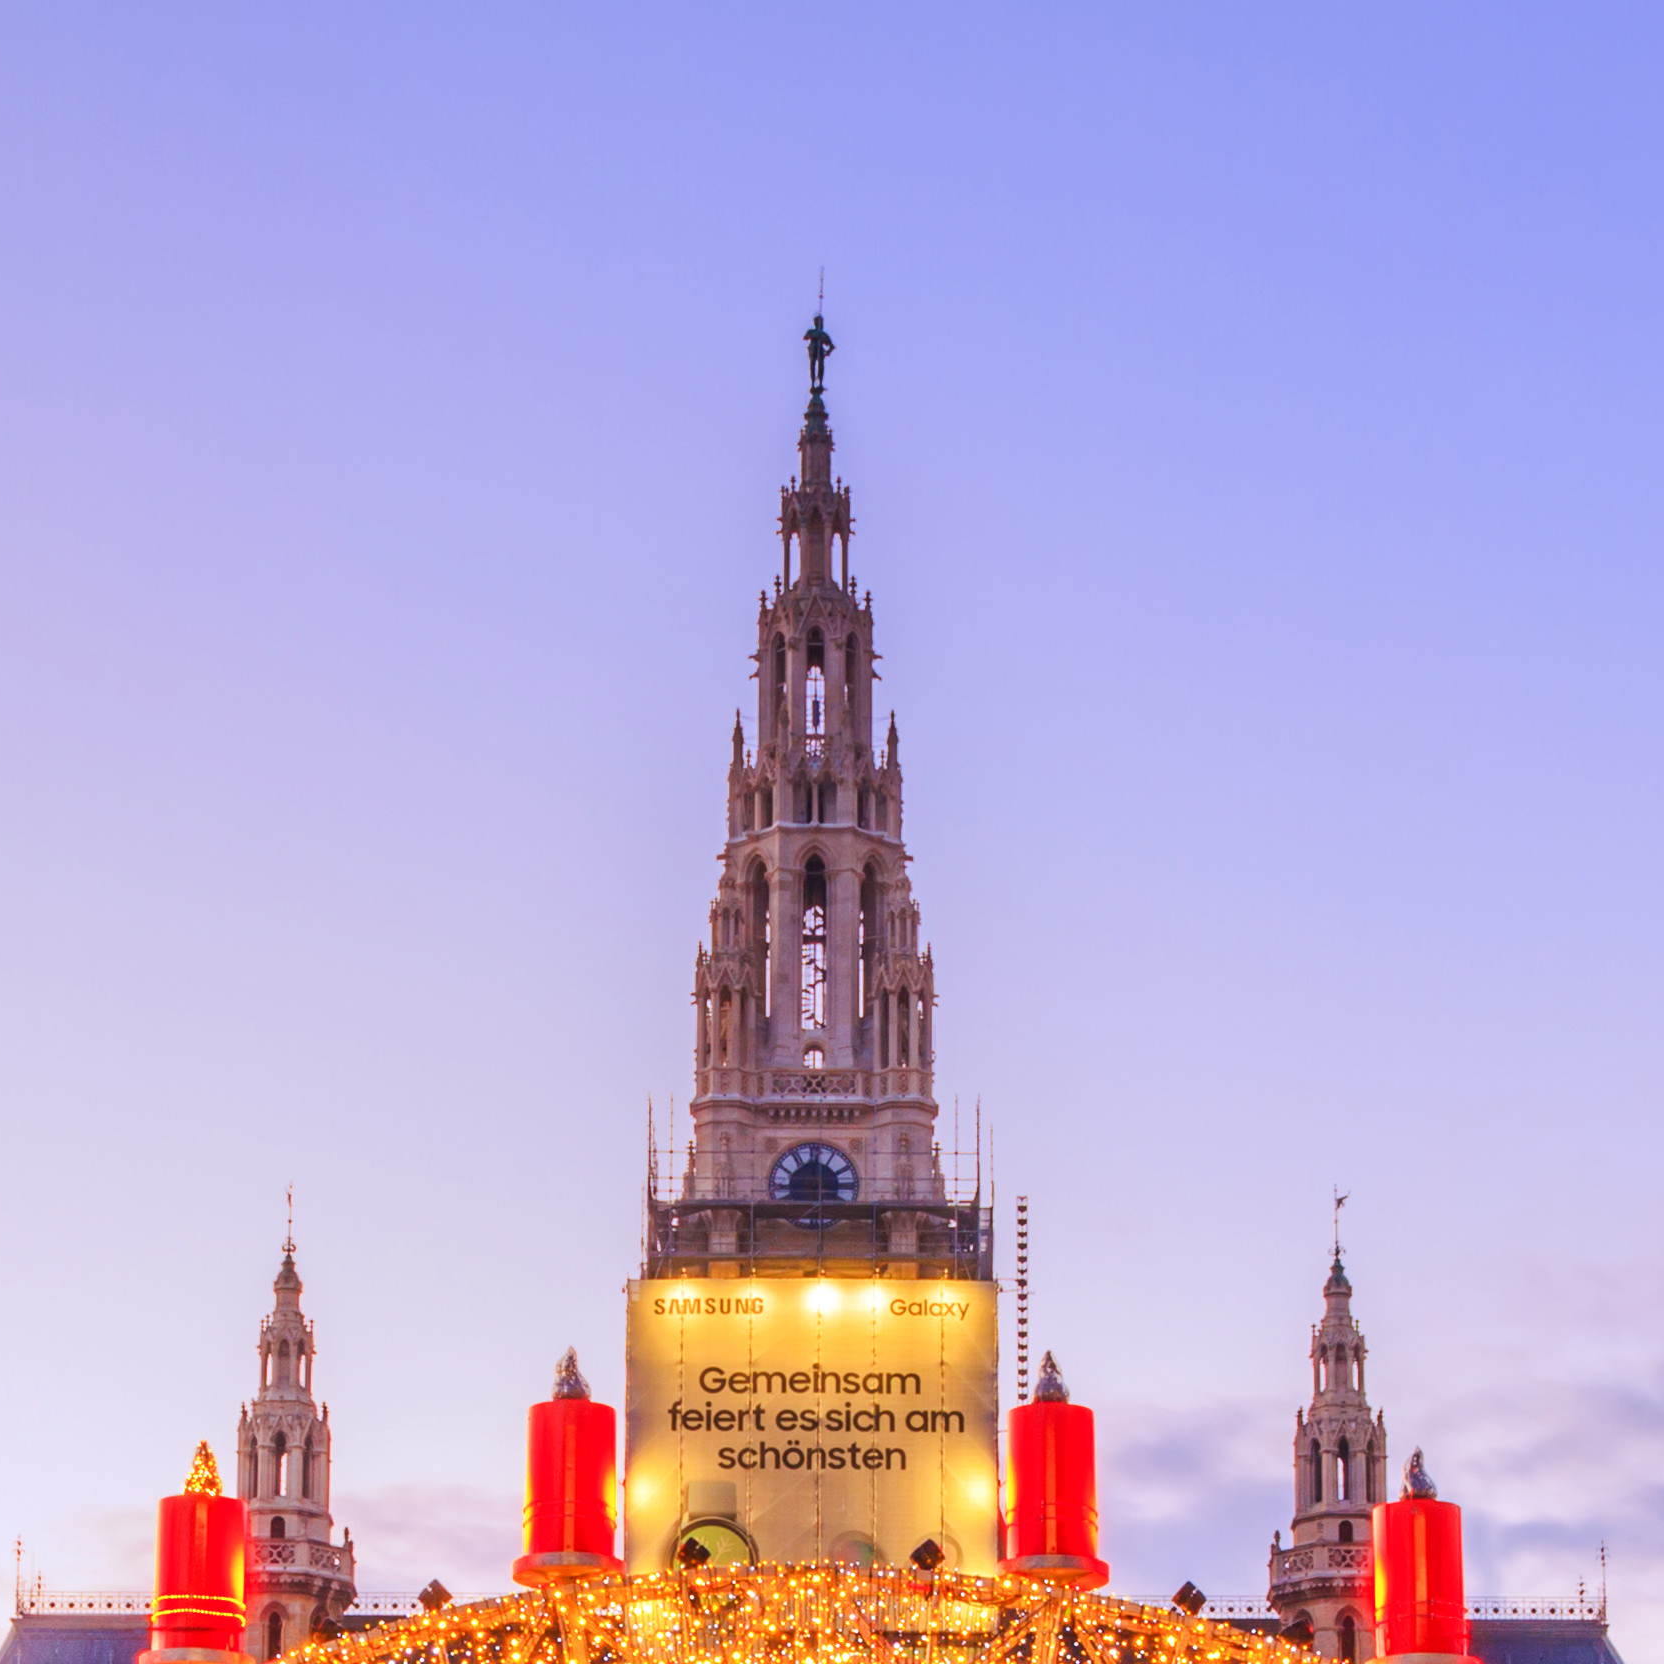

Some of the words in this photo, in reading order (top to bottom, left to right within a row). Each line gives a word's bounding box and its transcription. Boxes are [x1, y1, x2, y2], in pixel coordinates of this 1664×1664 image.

[653, 1297, 765, 1316] SAMSUNG
[889, 1298, 970, 1321] Galaxy
[698, 1363, 922, 1395] Gemeinsam
[668, 1401, 766, 1432] feiert
[775, 1408, 819, 1433] es
[824, 1401, 896, 1433] sich
[905, 1409, 966, 1433] am
[717, 1440, 907, 1470] schönsten
